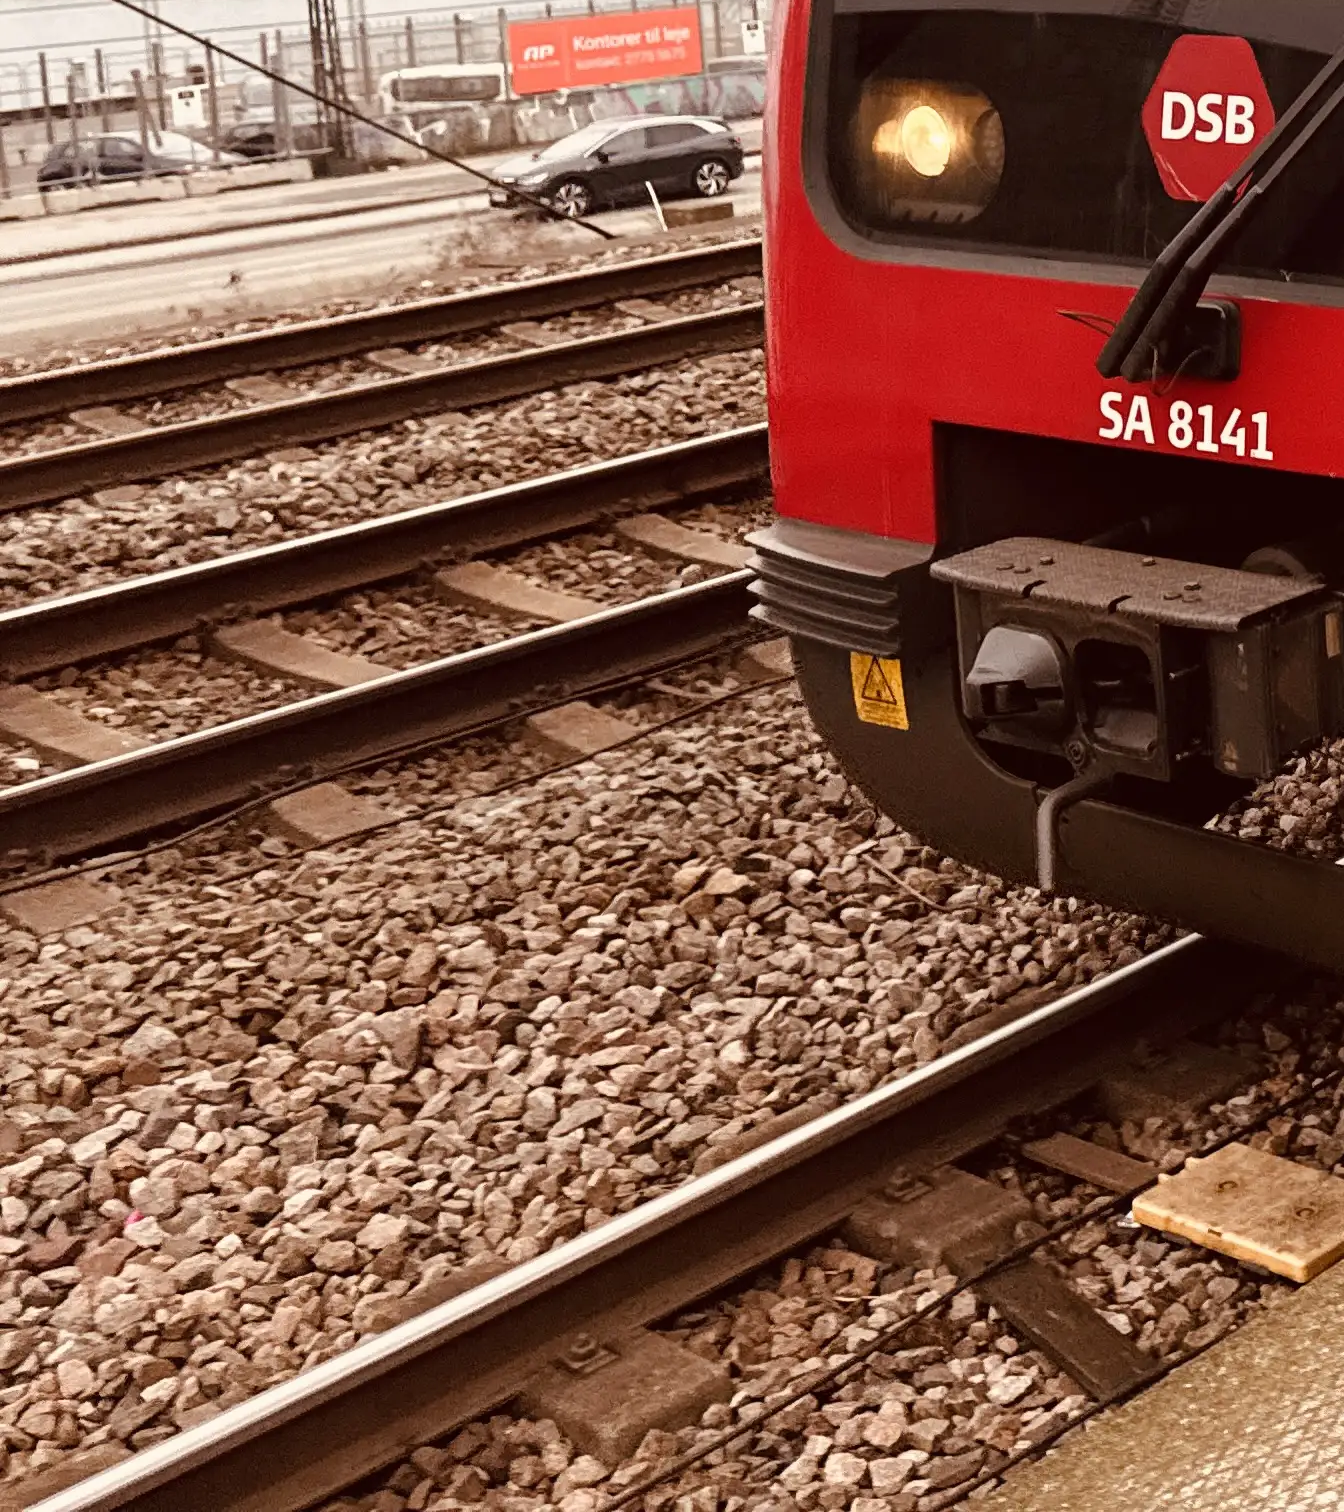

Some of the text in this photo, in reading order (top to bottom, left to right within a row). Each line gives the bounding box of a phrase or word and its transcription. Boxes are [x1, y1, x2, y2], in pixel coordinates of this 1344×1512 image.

[572, 32, 642, 52] Kontorer
[644, 27, 661, 44] til
[1161, 90, 1255, 145] DSB
[1098, 390, 1274, 461] SA 8141
